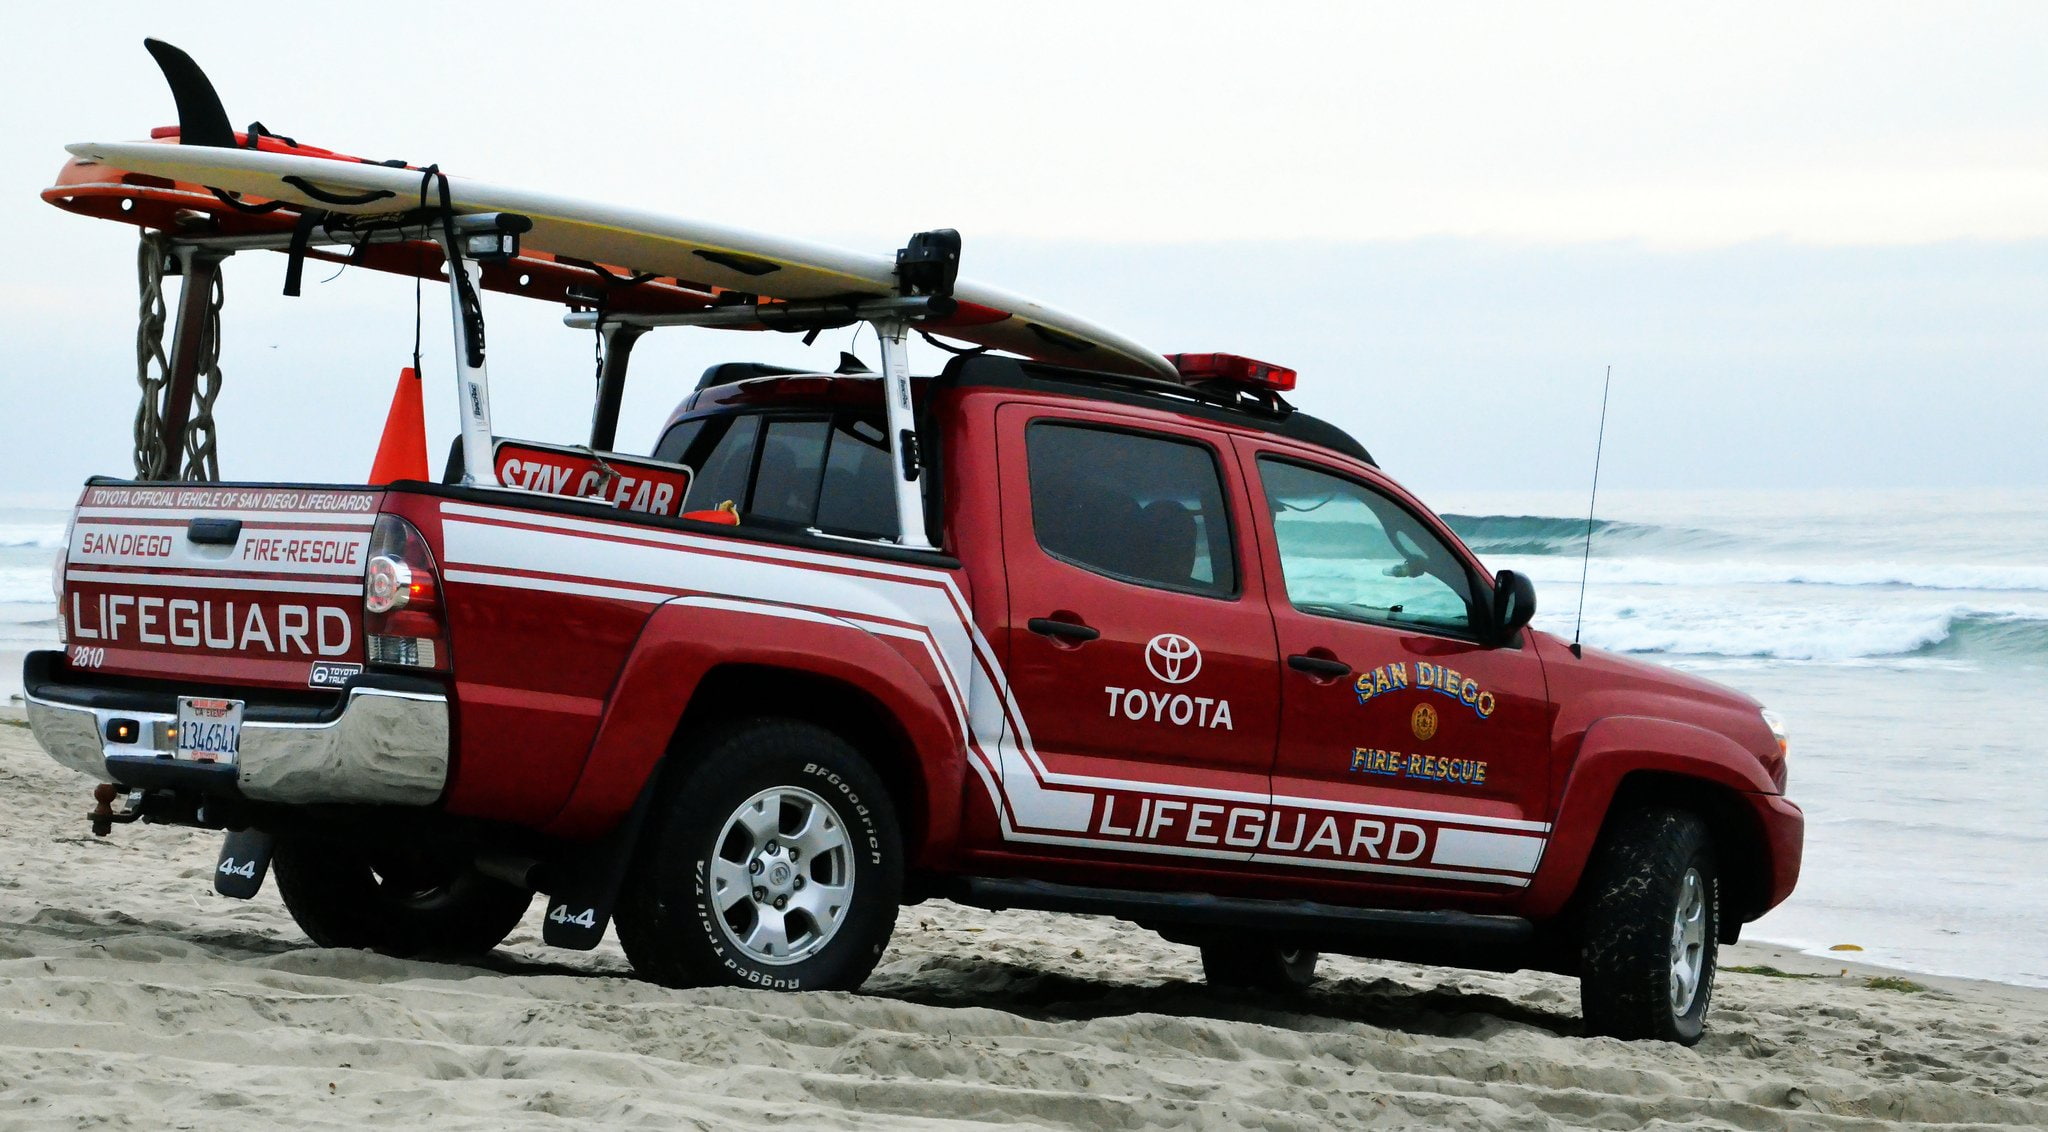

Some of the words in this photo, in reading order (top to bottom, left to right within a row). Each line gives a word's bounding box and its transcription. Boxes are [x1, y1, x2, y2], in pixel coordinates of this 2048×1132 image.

[502, 458, 574, 496] STAY
[91, 490, 130, 505] TOYOTA
[131, 491, 175, 506] OFFICIAL
[176, 492, 221, 507] VEHICLE
[221, 493, 239, 508] OF
[237, 493, 262, 508] SAN
[261, 493, 299, 509] DIEGO
[298, 494, 373, 511] LIFEGUARDS
[82, 532, 118, 554] SAN
[119, 534, 173, 557] DIEGO
[243, 538, 360, 565] FIRE-RESCUE
[73, 591, 352, 657] LIFEGUARD
[71, 646, 103, 669] 2810
[330, 667, 359, 676] TOYOTA
[328, 676, 348, 684] TRUC
[1354, 661, 1408, 705] SAN
[1415, 661, 1496, 719] DIEGO
[1105, 686, 1233, 731] TOYOTA
[180, 720, 235, 753] 1346541
[1350, 747, 1488, 785] FIRE-RESCUE
[803, 762, 881, 865] BFGoodrich
[1099, 794, 1427, 862] LIFEGUARD
[219, 857, 256, 879] 4x4
[695, 860, 706, 896] T/A
[549, 903, 596, 929] 4x4
[698, 903, 725, 957] Trail
[724, 957, 800, 990] Rugged
